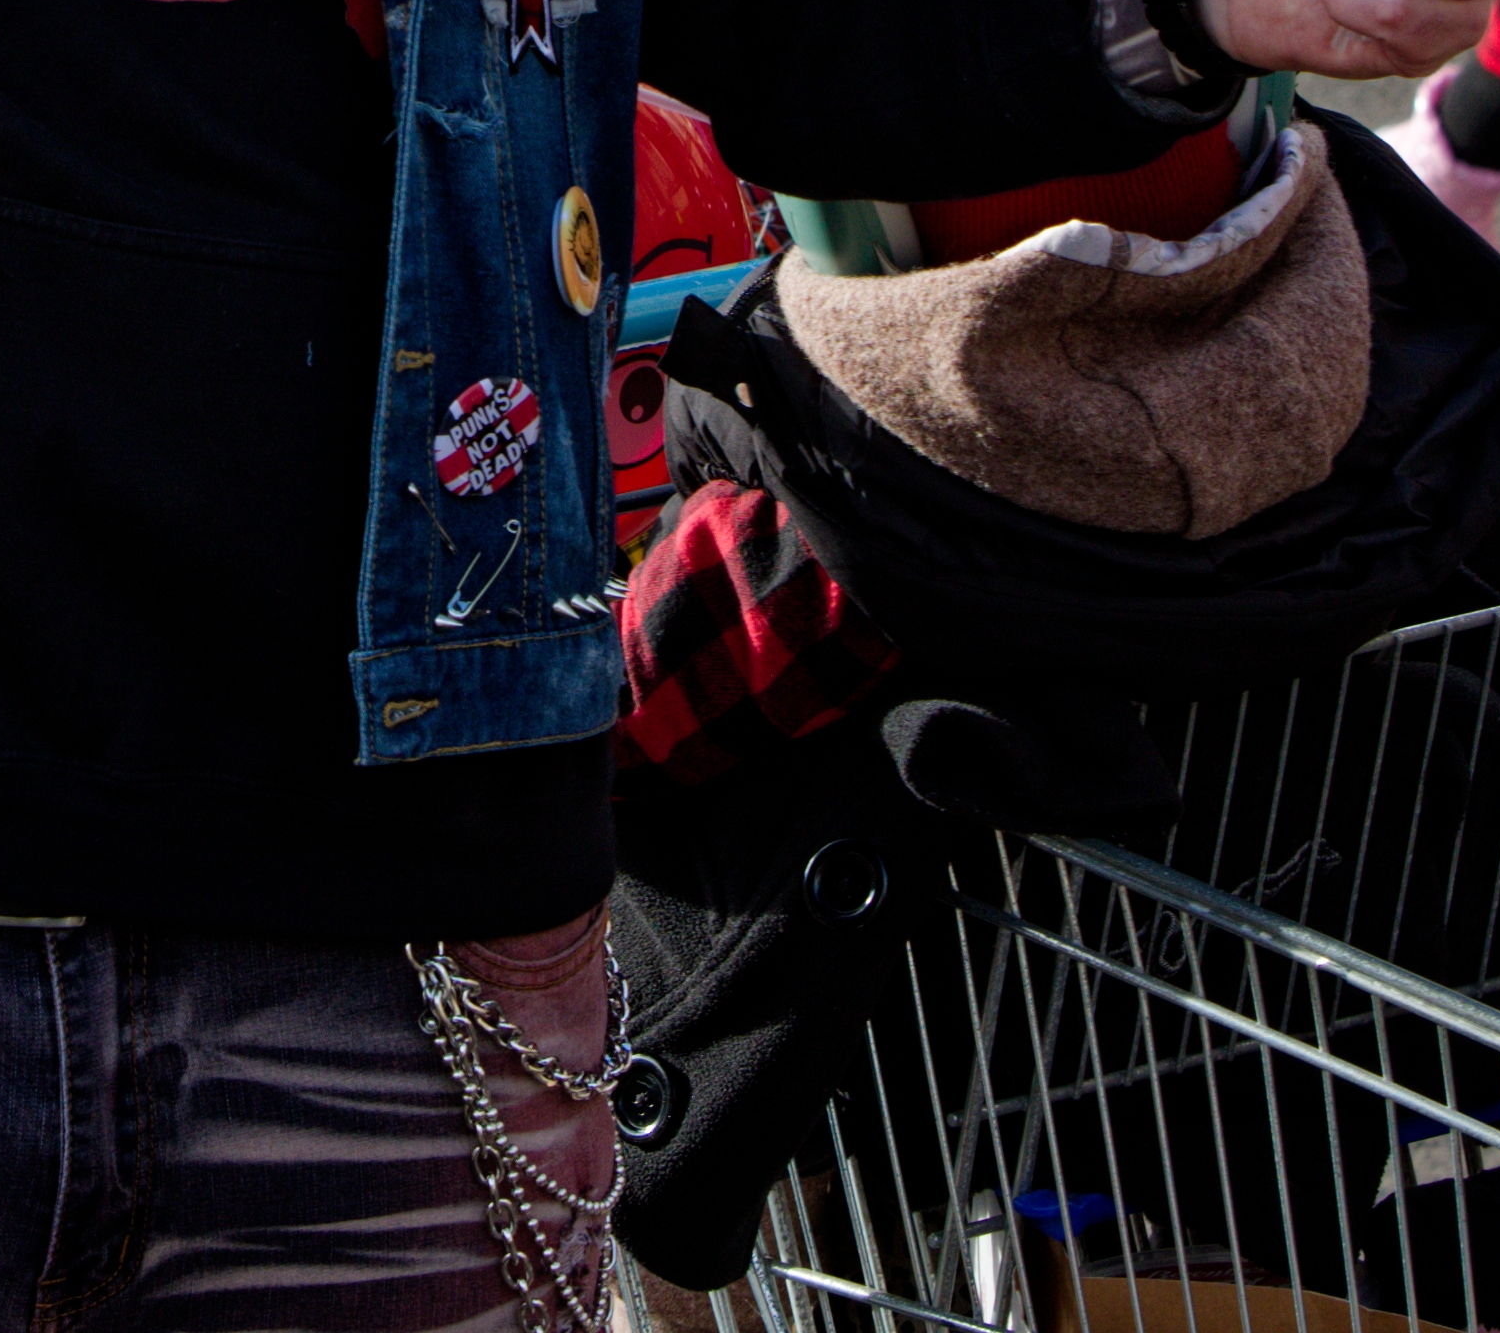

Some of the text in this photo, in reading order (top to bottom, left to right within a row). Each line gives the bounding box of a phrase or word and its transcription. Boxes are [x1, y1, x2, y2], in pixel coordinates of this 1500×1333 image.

[449, 388, 512, 449] PUNKS
[465, 419, 513, 465] NOT
[469, 436, 528, 491] DEAD!
